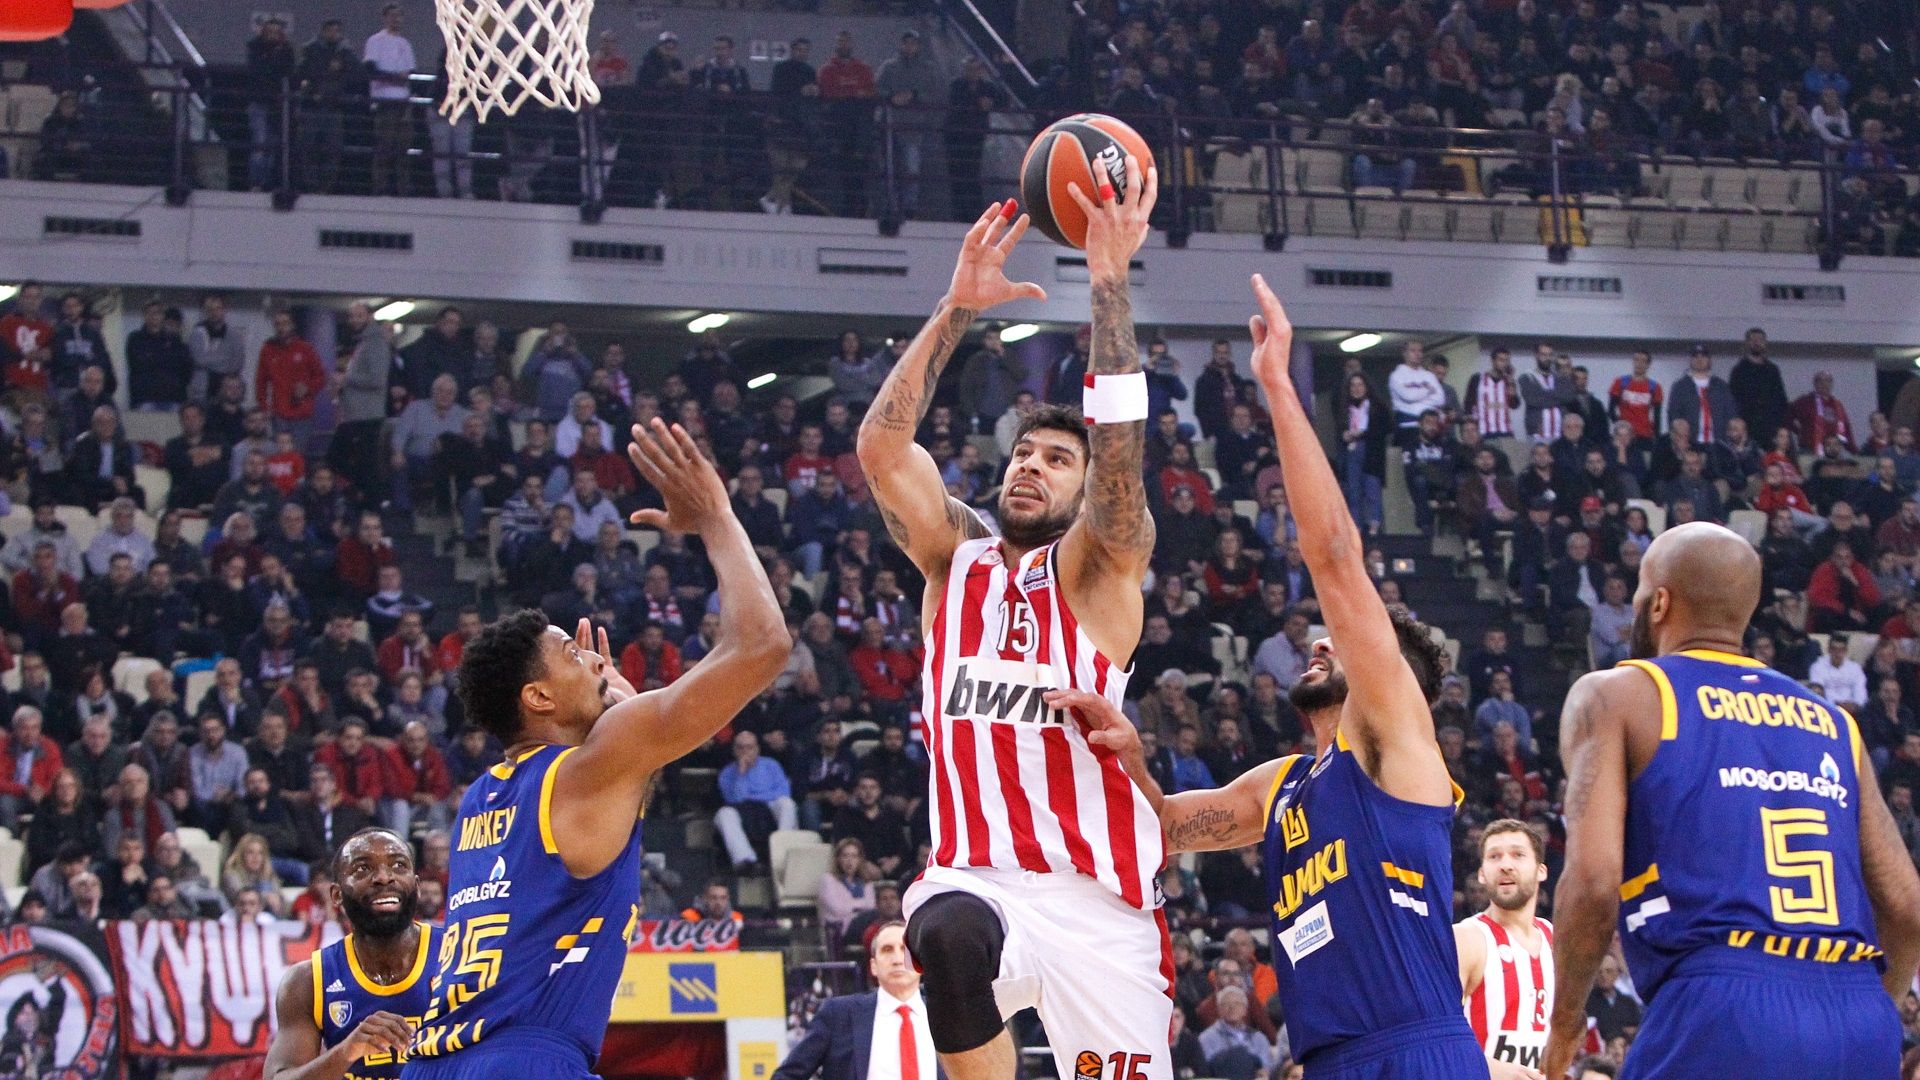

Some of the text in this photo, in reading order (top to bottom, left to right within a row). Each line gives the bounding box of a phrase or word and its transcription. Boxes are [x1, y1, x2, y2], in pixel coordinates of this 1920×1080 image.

[995, 599, 1036, 655] 15
[1697, 684, 1838, 740] CROCKER
[457, 805, 517, 852] MICKEY
[1760, 806, 1841, 927] 5
